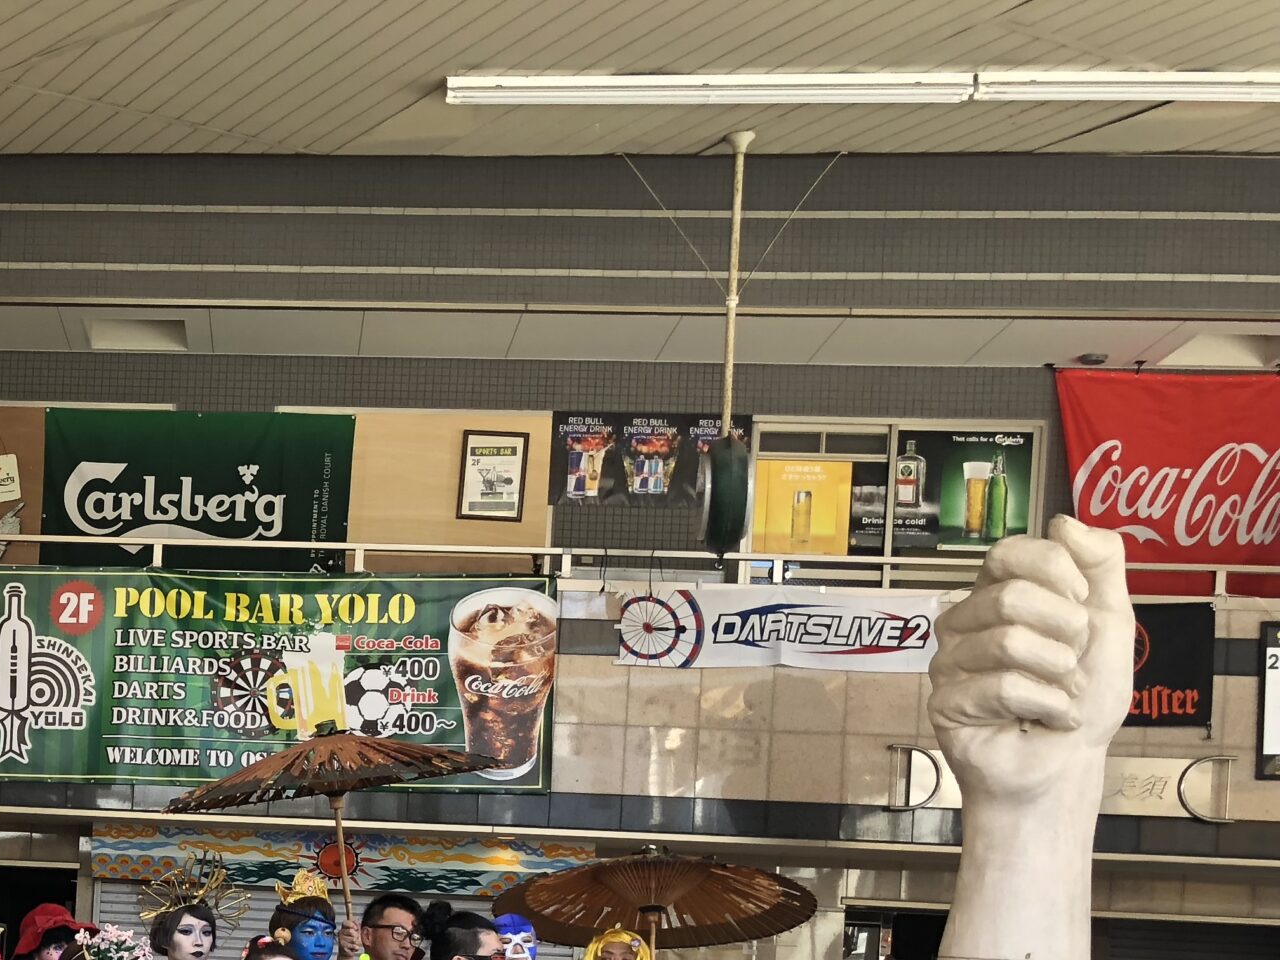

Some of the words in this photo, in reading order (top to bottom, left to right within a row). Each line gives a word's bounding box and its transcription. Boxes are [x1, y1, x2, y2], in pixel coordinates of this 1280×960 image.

[558, 424, 588, 433] ENERGY
[589, 425, 614, 433] DRINK
[568, 417, 584, 425] RED
[585, 417, 604, 425] BULL
[623, 426, 653, 435] ENERGY
[654, 427, 678, 435] DRINK
[632, 418, 648, 427] RED
[649, 419, 669, 427] BULL
[689, 427, 720, 436] ENERGY
[698, 419, 714, 428] RED
[64, 461, 287, 549] Carlsberg
[321, 481, 330, 512] DANISH
[310, 500, 319, 543] PPOINTMENT
[58, 592, 96, 624] 2F
[113, 586, 214, 620] POOL
[224, 592, 307, 625] BAR
[315, 592, 416, 625] YOLO
[113, 628, 167, 648] LIVE
[170, 630, 256, 650] SPORTS
[261, 634, 311, 653] BAR
[712, 611, 931, 649] DARTSLIVE2
[354, 635, 441, 650] Coca-Cola
[35, 638, 94, 704] SHINSEKAI
[113, 655, 231, 676] BILLIARDS
[381, 658, 440, 679] ¥400
[112, 681, 187, 700] DARTS
[388, 688, 439, 704] Drink
[29, 710, 84, 727] YOLO
[111, 707, 262, 729] DRINK&FOOD
[106, 746, 201, 767] WELCOME
[206, 749, 234, 767] TO
